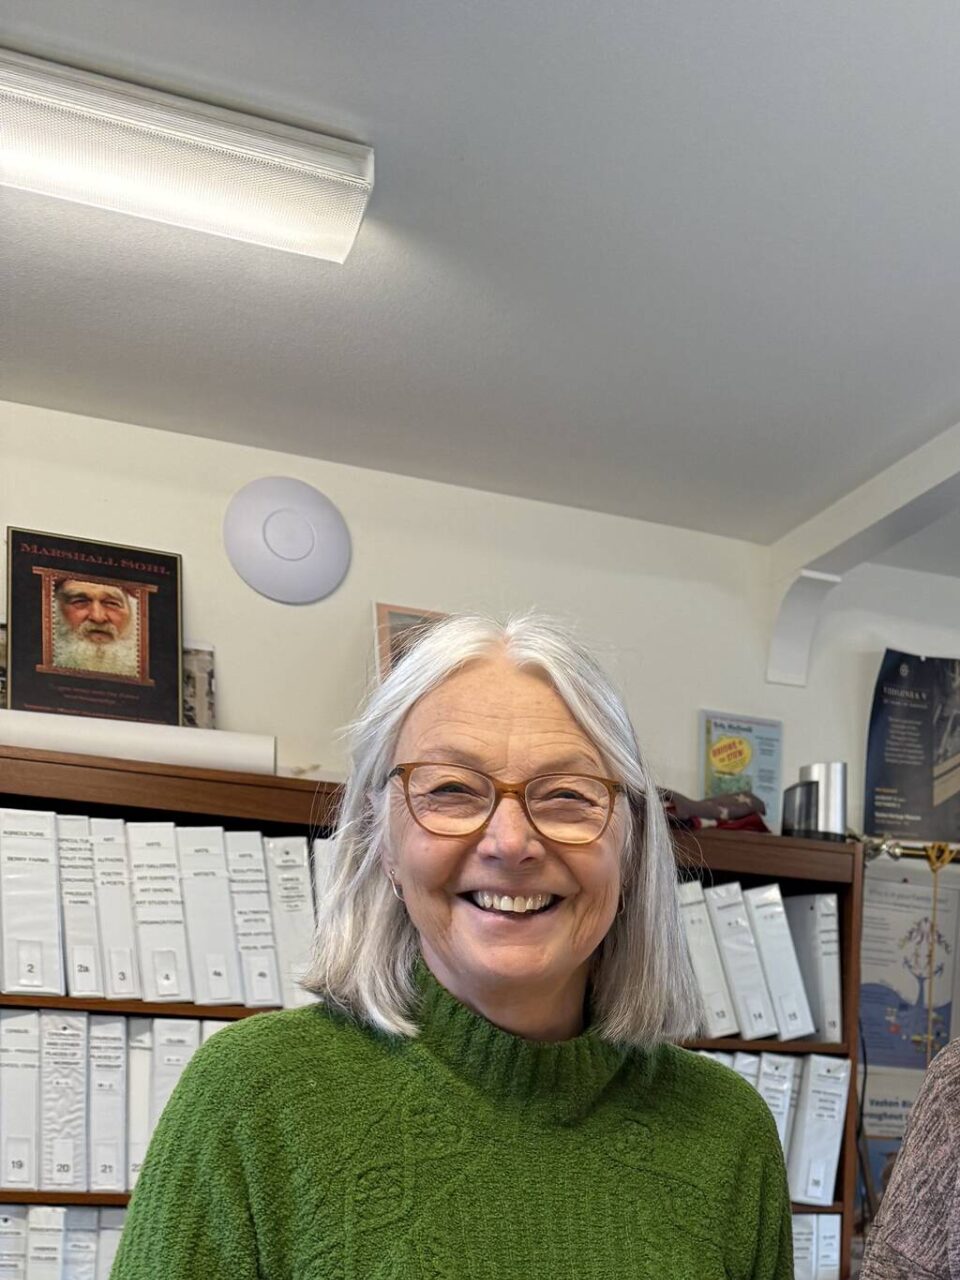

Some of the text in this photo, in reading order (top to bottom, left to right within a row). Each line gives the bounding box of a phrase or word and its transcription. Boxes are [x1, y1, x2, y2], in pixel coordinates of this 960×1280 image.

[26, 963, 35, 974] 2
[118, 971, 127, 982] 3
[753, 1012, 763, 1020] 14
[11, 1160, 24, 1170] 19
[56, 1163, 71, 1173] 20
[100, 1164, 113, 1173] 21
